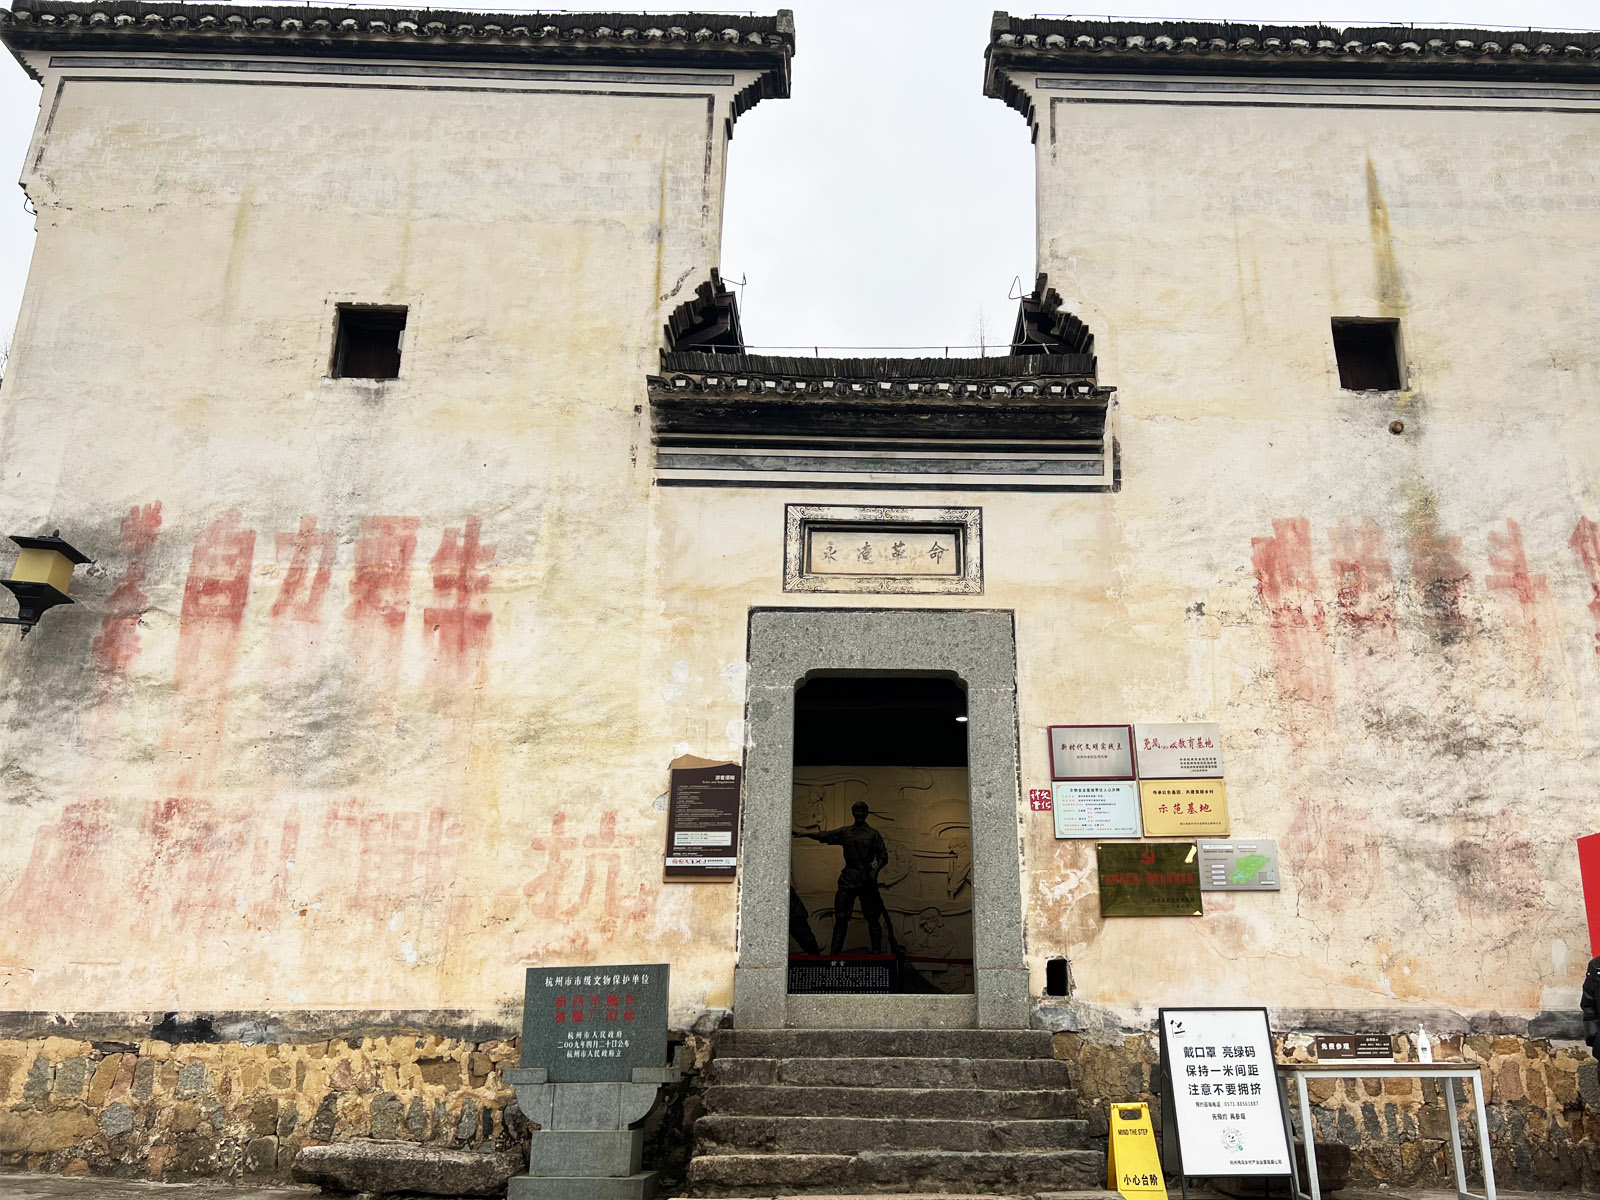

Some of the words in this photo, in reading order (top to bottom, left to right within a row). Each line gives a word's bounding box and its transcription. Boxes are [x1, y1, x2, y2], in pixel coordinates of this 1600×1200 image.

[1158, 802, 1212, 814] 示范基地
[545, 974, 650, 987] 杭州市市级文物保护单位
[568, 1031, 622, 1039] 杭州市人民政府
[566, 1049, 621, 1058] 杭州市人民政府立
[1184, 1046, 1216, 1058] 戴口罩
[1222, 1046, 1255, 1058] 亮绿码
[1186, 1065, 1259, 1077] 保持一米间距
[1189, 1083, 1261, 1095] 注意不要拥挤
[1124, 1174, 1158, 1186] 小心台阶
